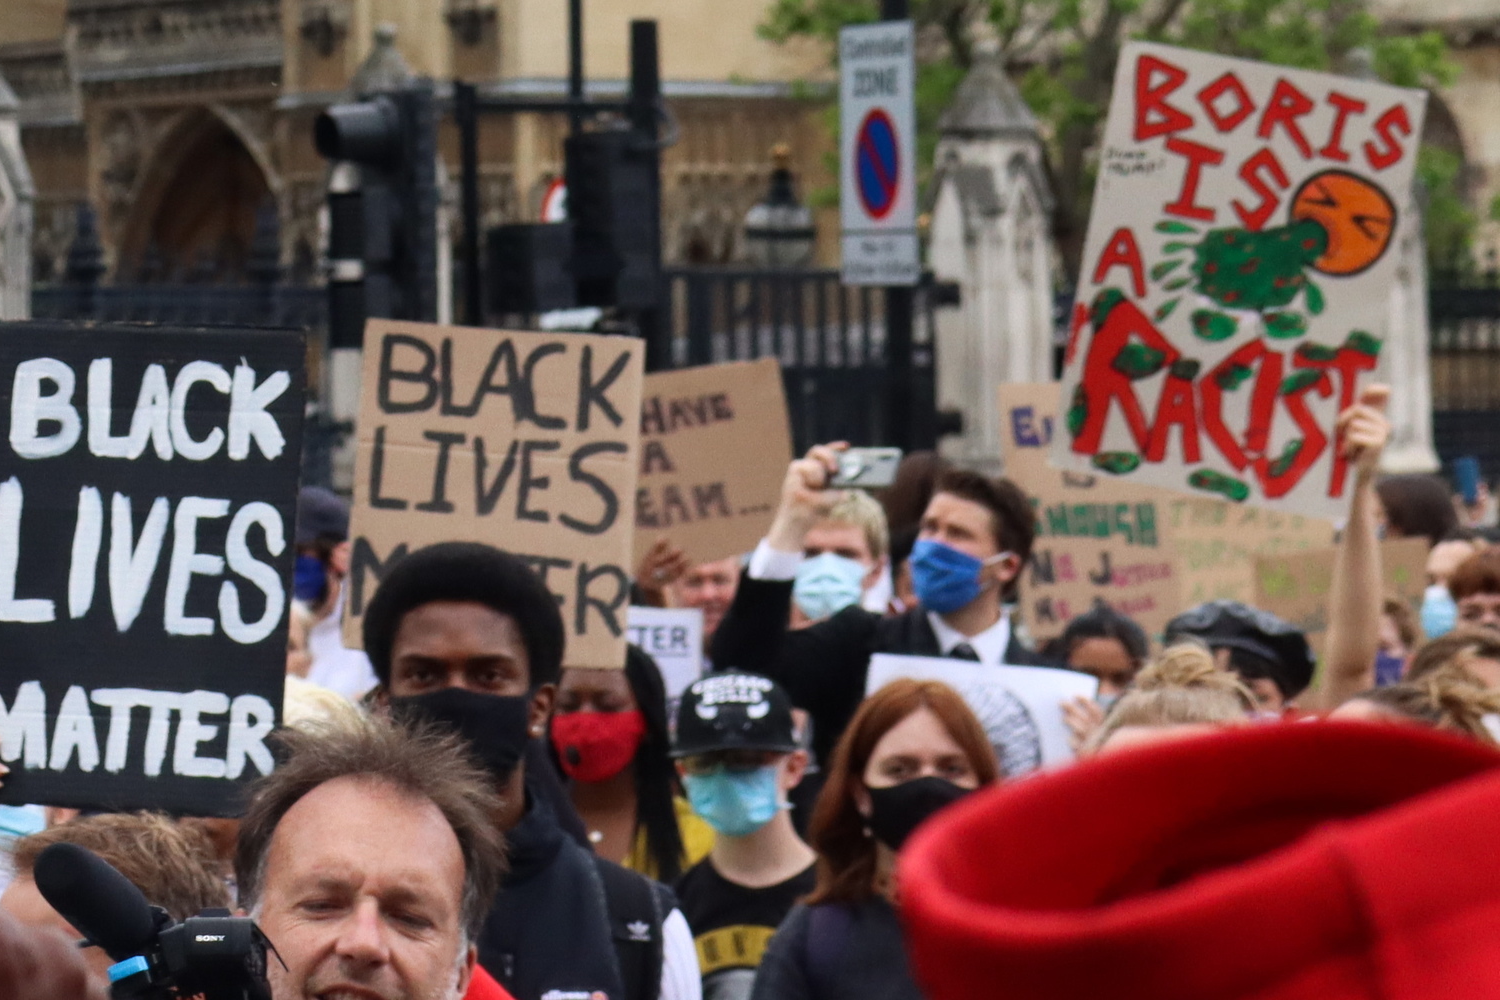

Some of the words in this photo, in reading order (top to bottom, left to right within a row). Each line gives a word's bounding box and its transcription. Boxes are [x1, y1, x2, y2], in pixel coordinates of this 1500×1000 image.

[1133, 54, 1412, 172] BORIS
[1162, 136, 1291, 231] IS
[1092, 228, 1147, 298] A
[9, 356, 292, 461] BLACK
[376, 333, 632, 432] BLACK
[640, 393, 734, 434] HAVE
[1070, 298, 1378, 499] RACIST
[368, 425, 629, 536] LIVES
[643, 440, 674, 475] A
[195, 934, 226, 942] SONY
